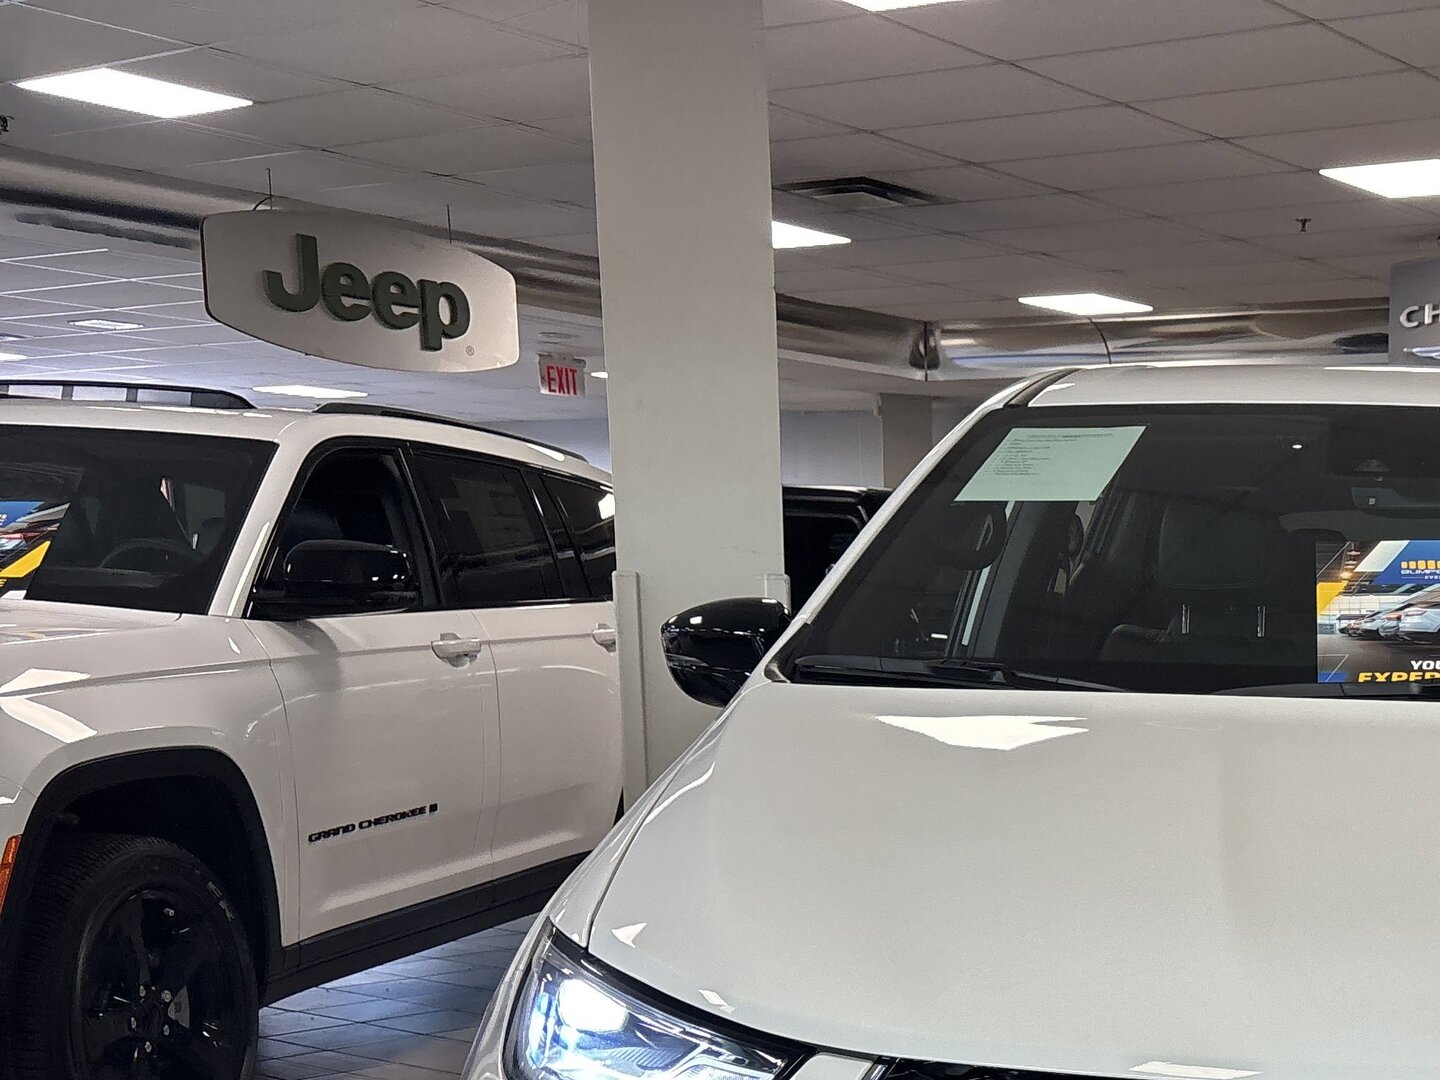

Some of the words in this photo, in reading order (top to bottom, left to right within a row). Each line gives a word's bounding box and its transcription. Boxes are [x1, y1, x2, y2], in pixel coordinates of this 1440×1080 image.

[262, 232, 471, 352] Jeep
[546, 365, 577, 396] EXIT
[308, 823, 356, 843] GRAND
[358, 805, 427, 830] CHEROKEE
